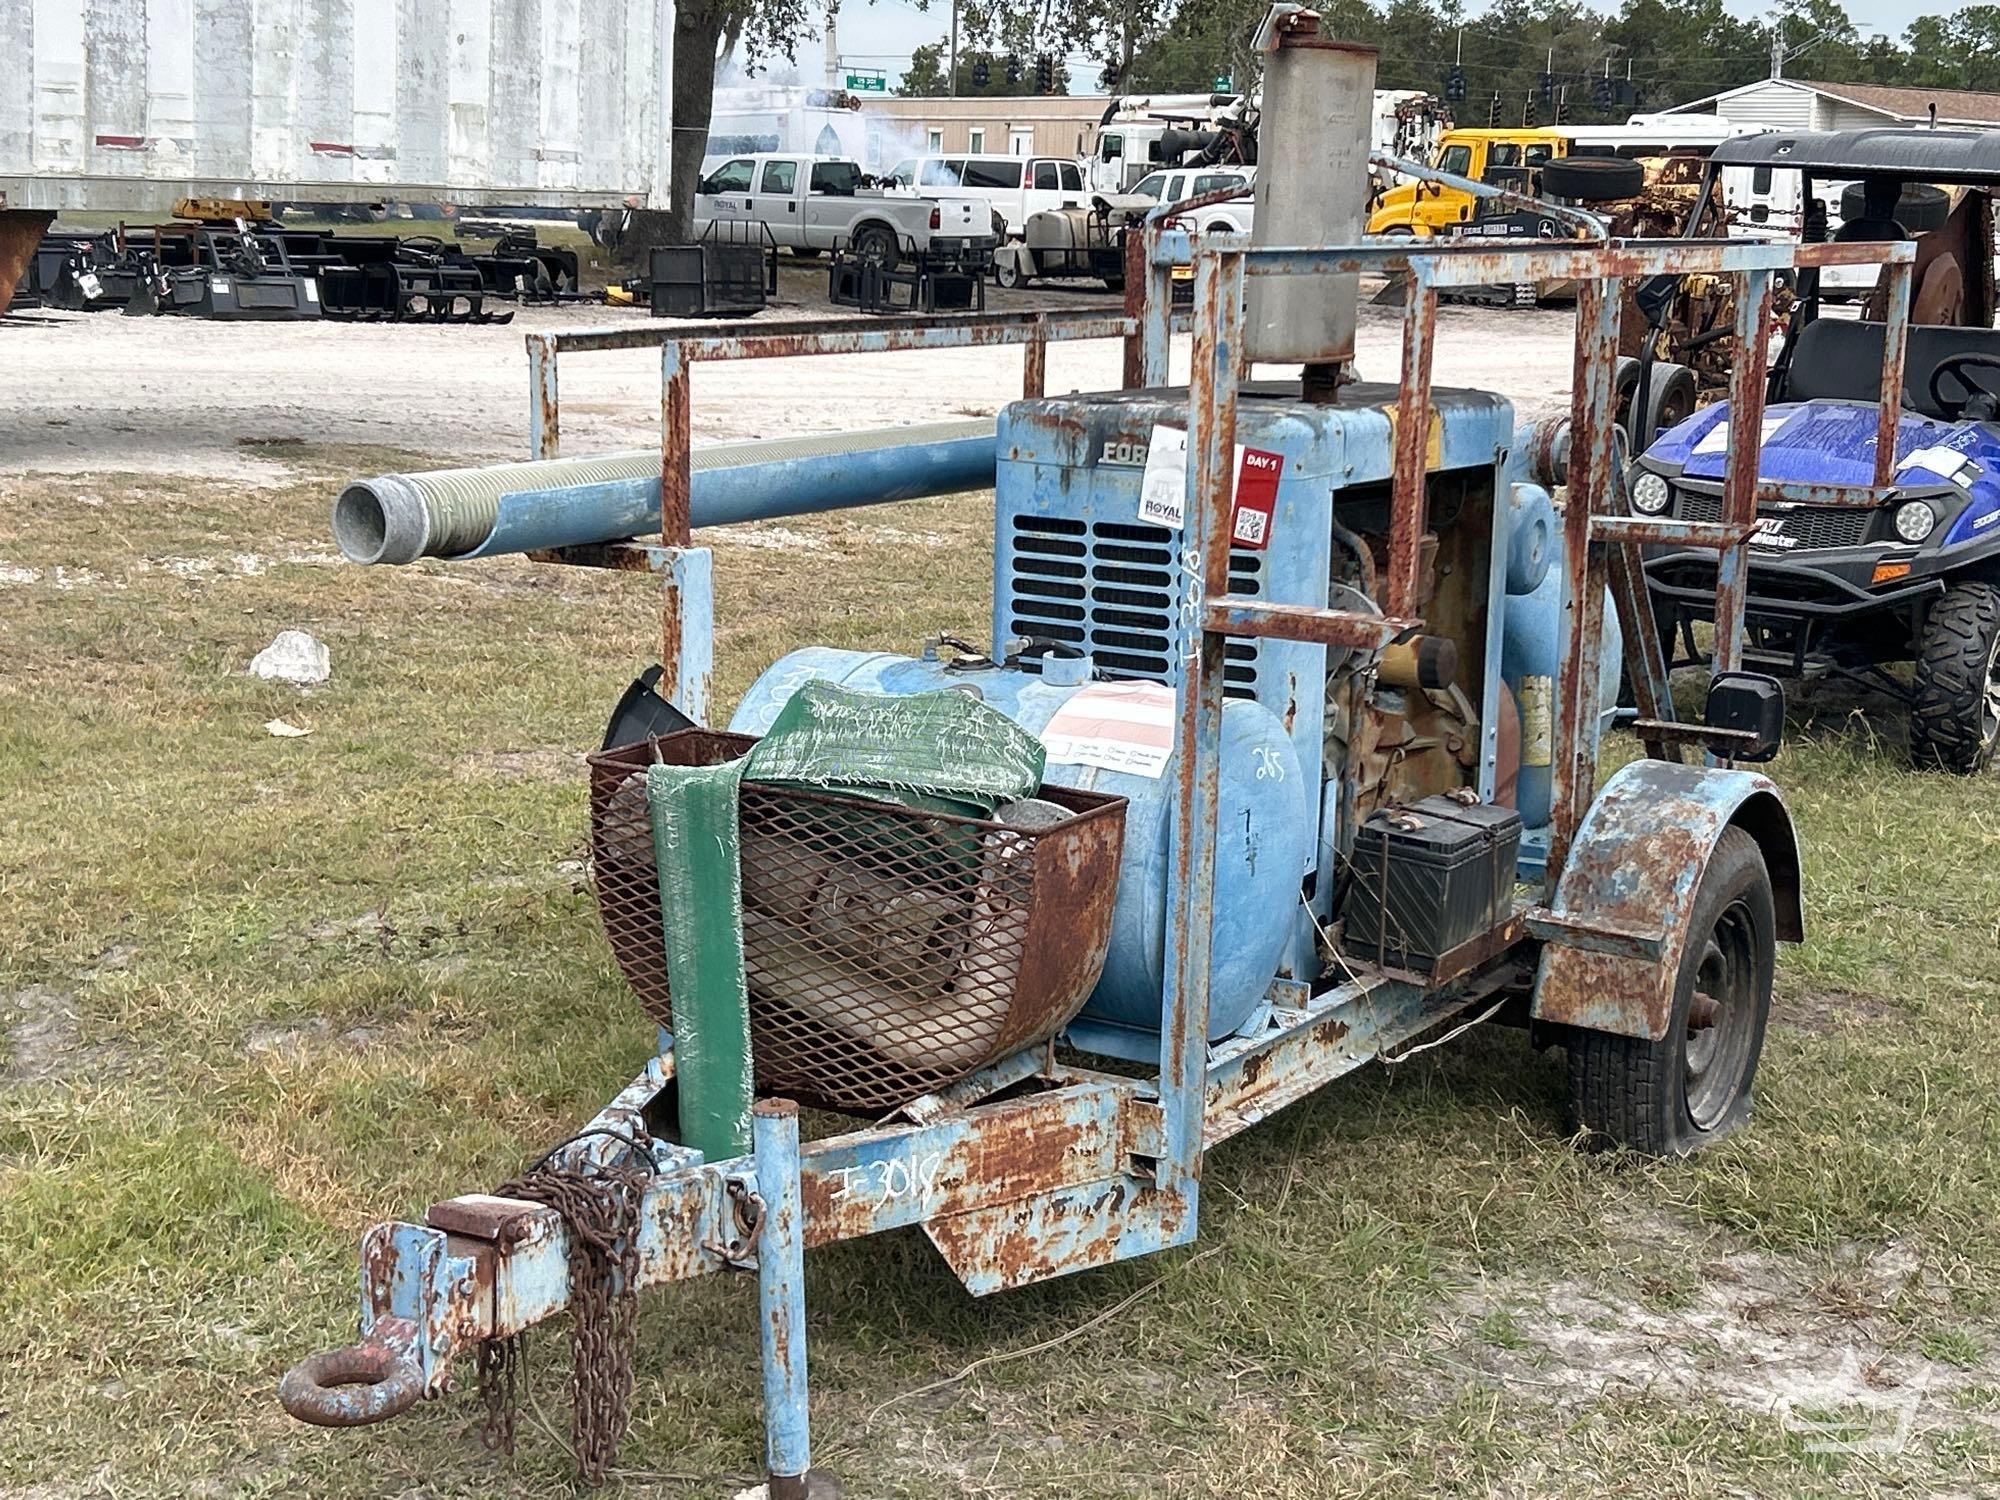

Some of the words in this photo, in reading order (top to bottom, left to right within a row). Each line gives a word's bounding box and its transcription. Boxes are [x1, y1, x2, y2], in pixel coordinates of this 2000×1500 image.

[1103, 442, 1148, 464] FOR
[1246, 454, 1270, 468] DAY
[1270, 460, 1278, 471] 1
[1145, 500, 1182, 519] ROYAL
[1748, 532, 1799, 549] Master
